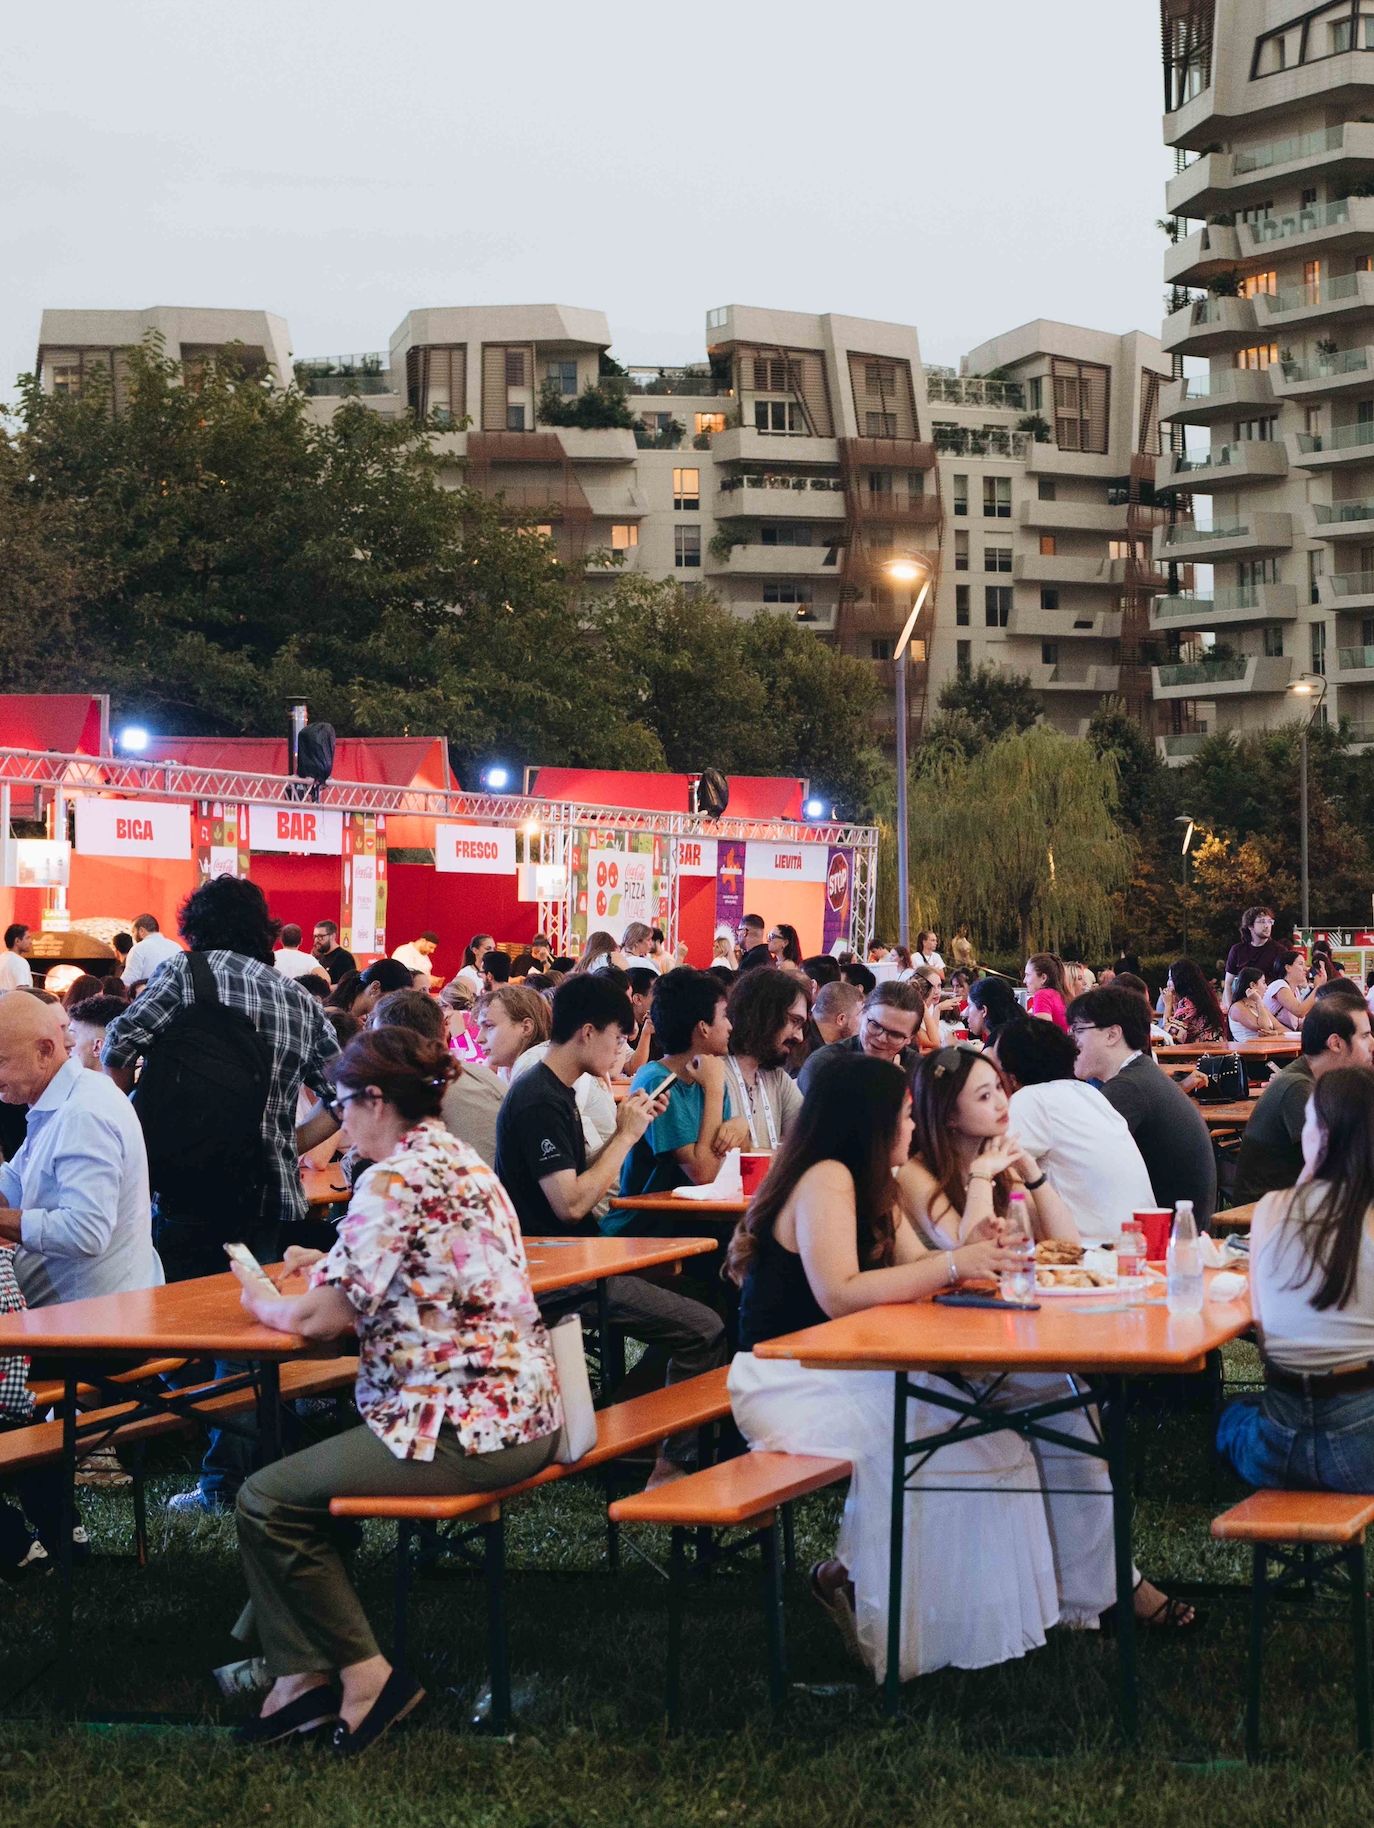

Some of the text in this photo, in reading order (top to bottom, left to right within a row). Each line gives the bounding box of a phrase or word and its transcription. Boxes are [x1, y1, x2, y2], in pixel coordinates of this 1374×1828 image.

[116, 818, 154, 841] BIGA
[277, 811, 316, 842] BAR
[455, 840, 498, 860] FRESCO
[774, 851, 802, 870] LIEVITÀ
[624, 881, 646, 900] PIZZA
[829, 867, 847, 896] STOP
